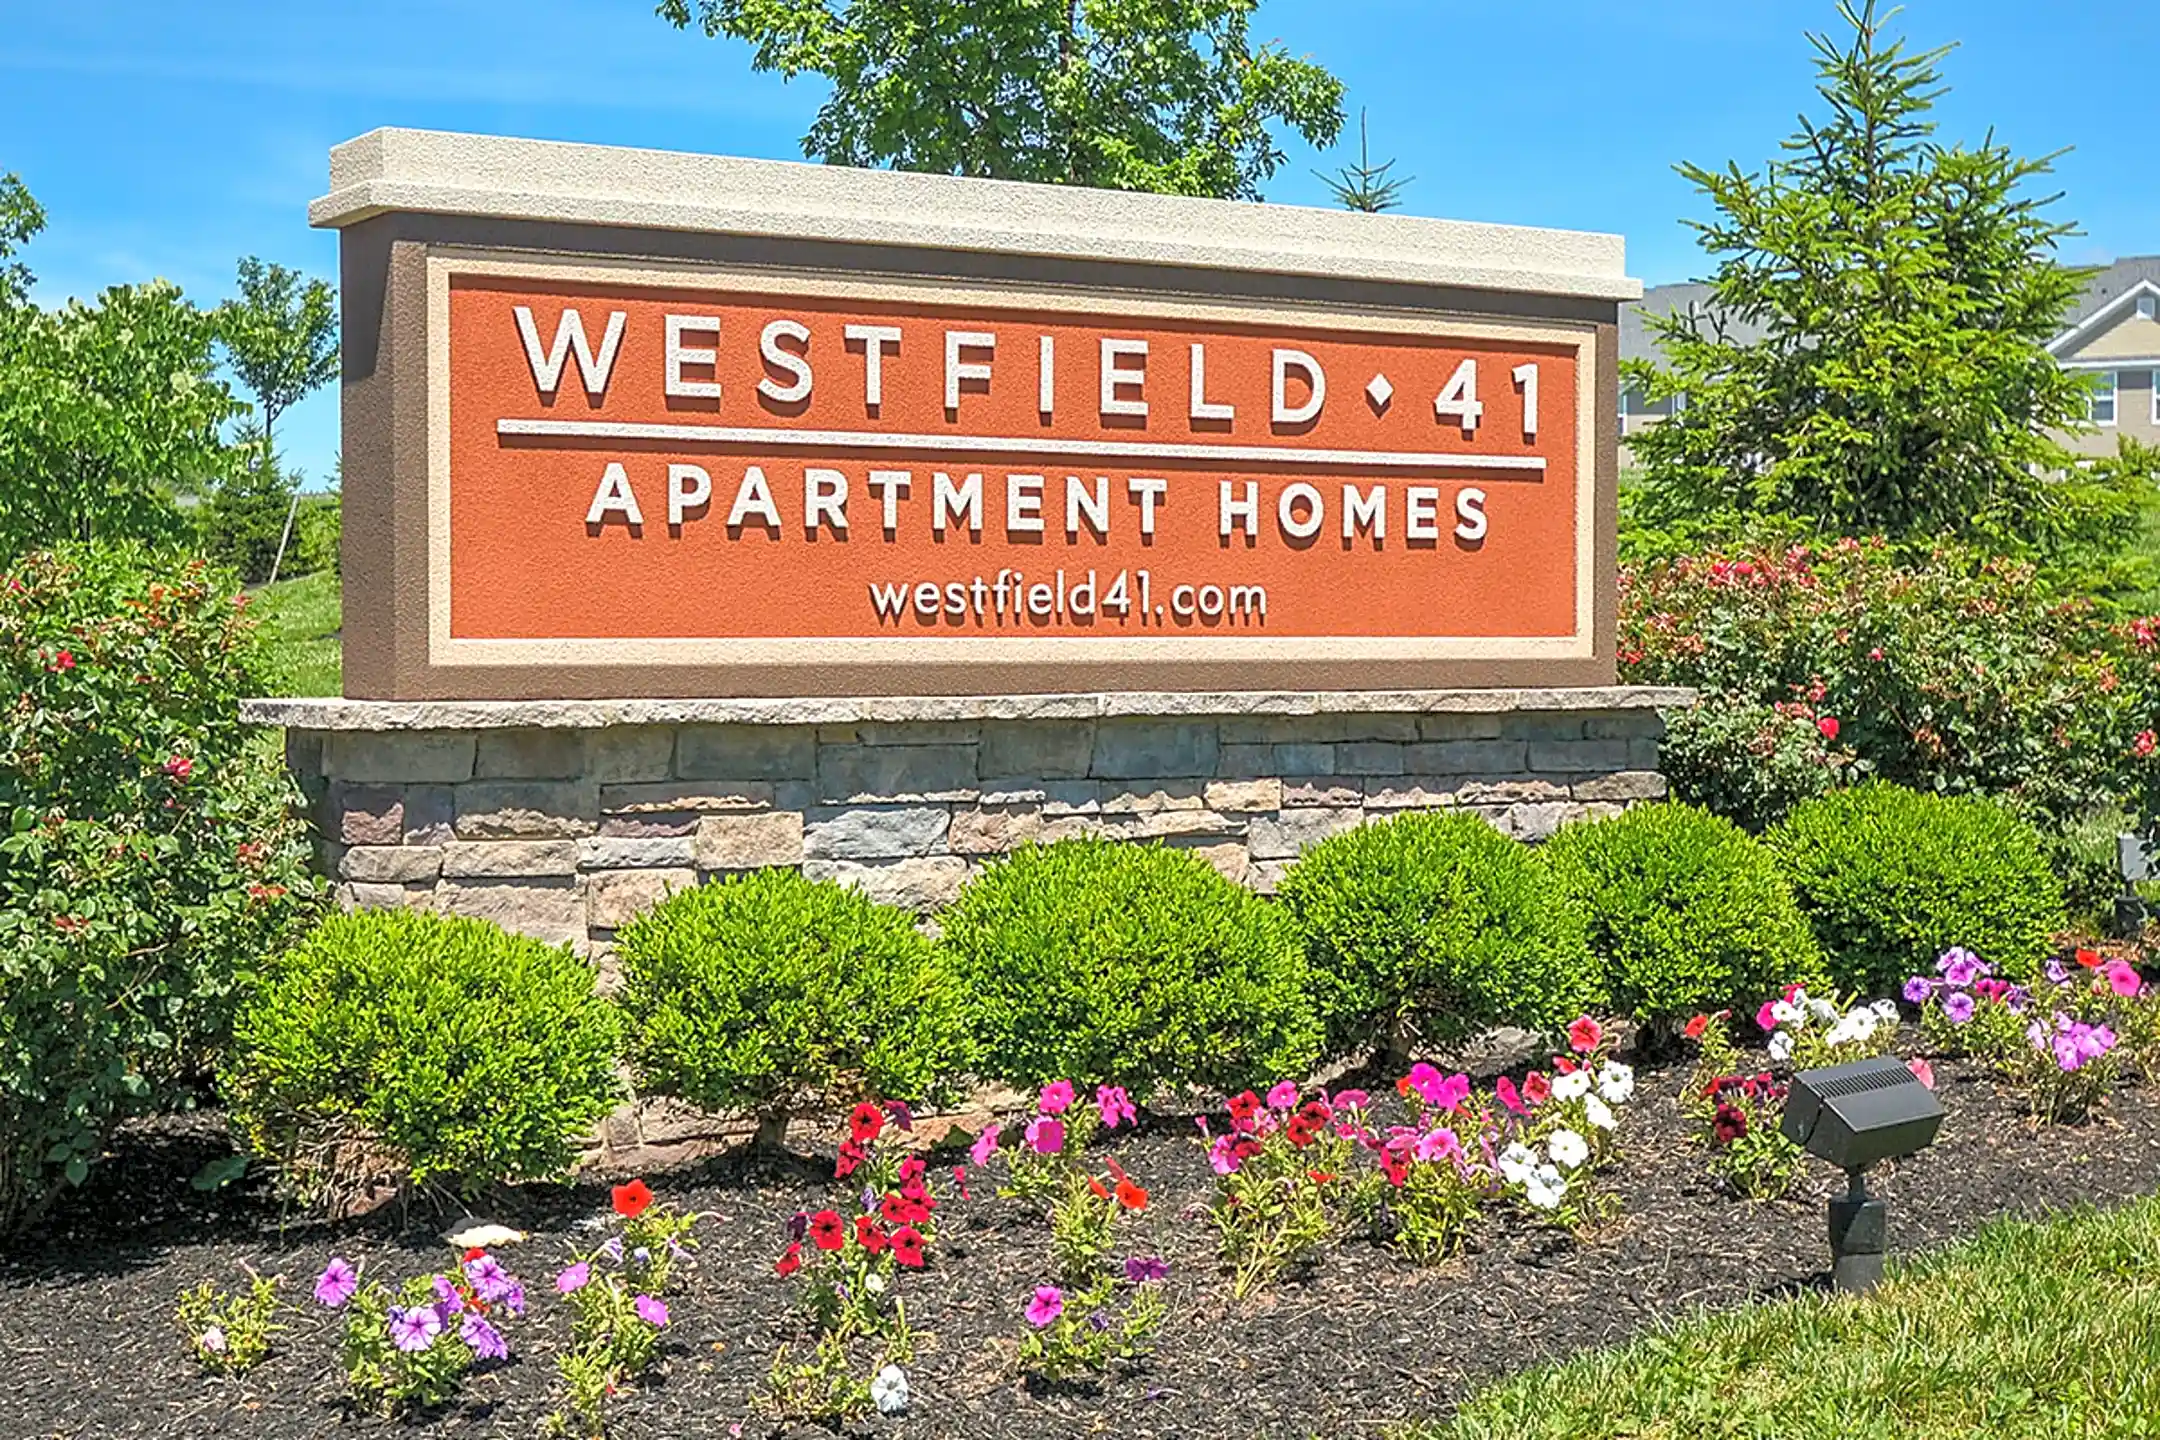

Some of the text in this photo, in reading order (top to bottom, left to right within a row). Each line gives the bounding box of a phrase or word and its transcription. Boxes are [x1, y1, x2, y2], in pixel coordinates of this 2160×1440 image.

[512, 305, 1539, 435] WESTFIELD 41
[585, 461, 1489, 541] APARTMENT HOMES
[869, 567, 1268, 616] westfield41.com
